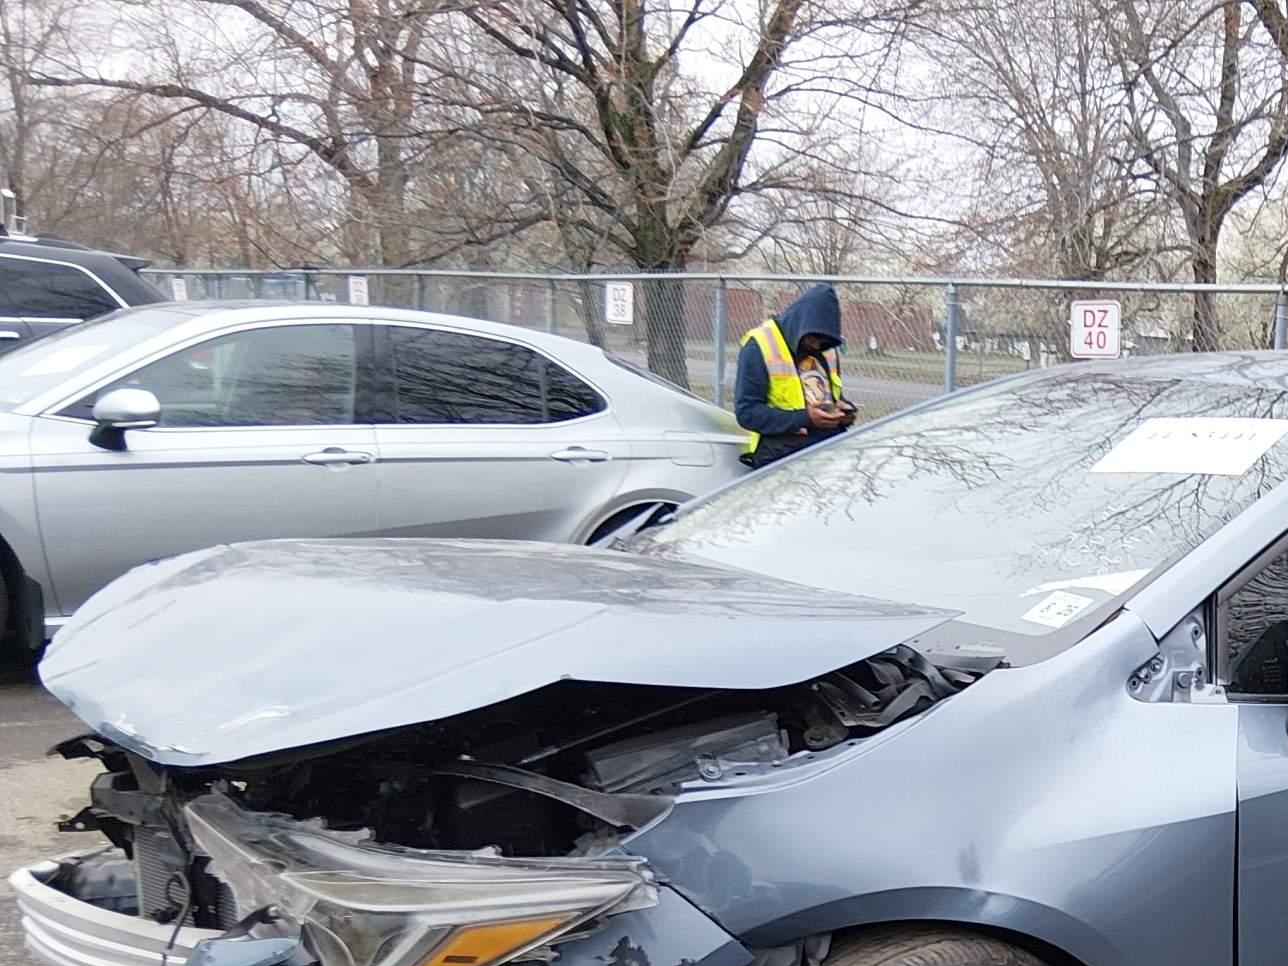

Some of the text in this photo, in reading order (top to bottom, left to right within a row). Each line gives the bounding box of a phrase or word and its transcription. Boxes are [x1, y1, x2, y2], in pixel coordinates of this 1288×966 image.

[612, 287, 627, 302] DZ
[1083, 309, 1109, 328] DZ
[1083, 330, 1107, 350] 40
